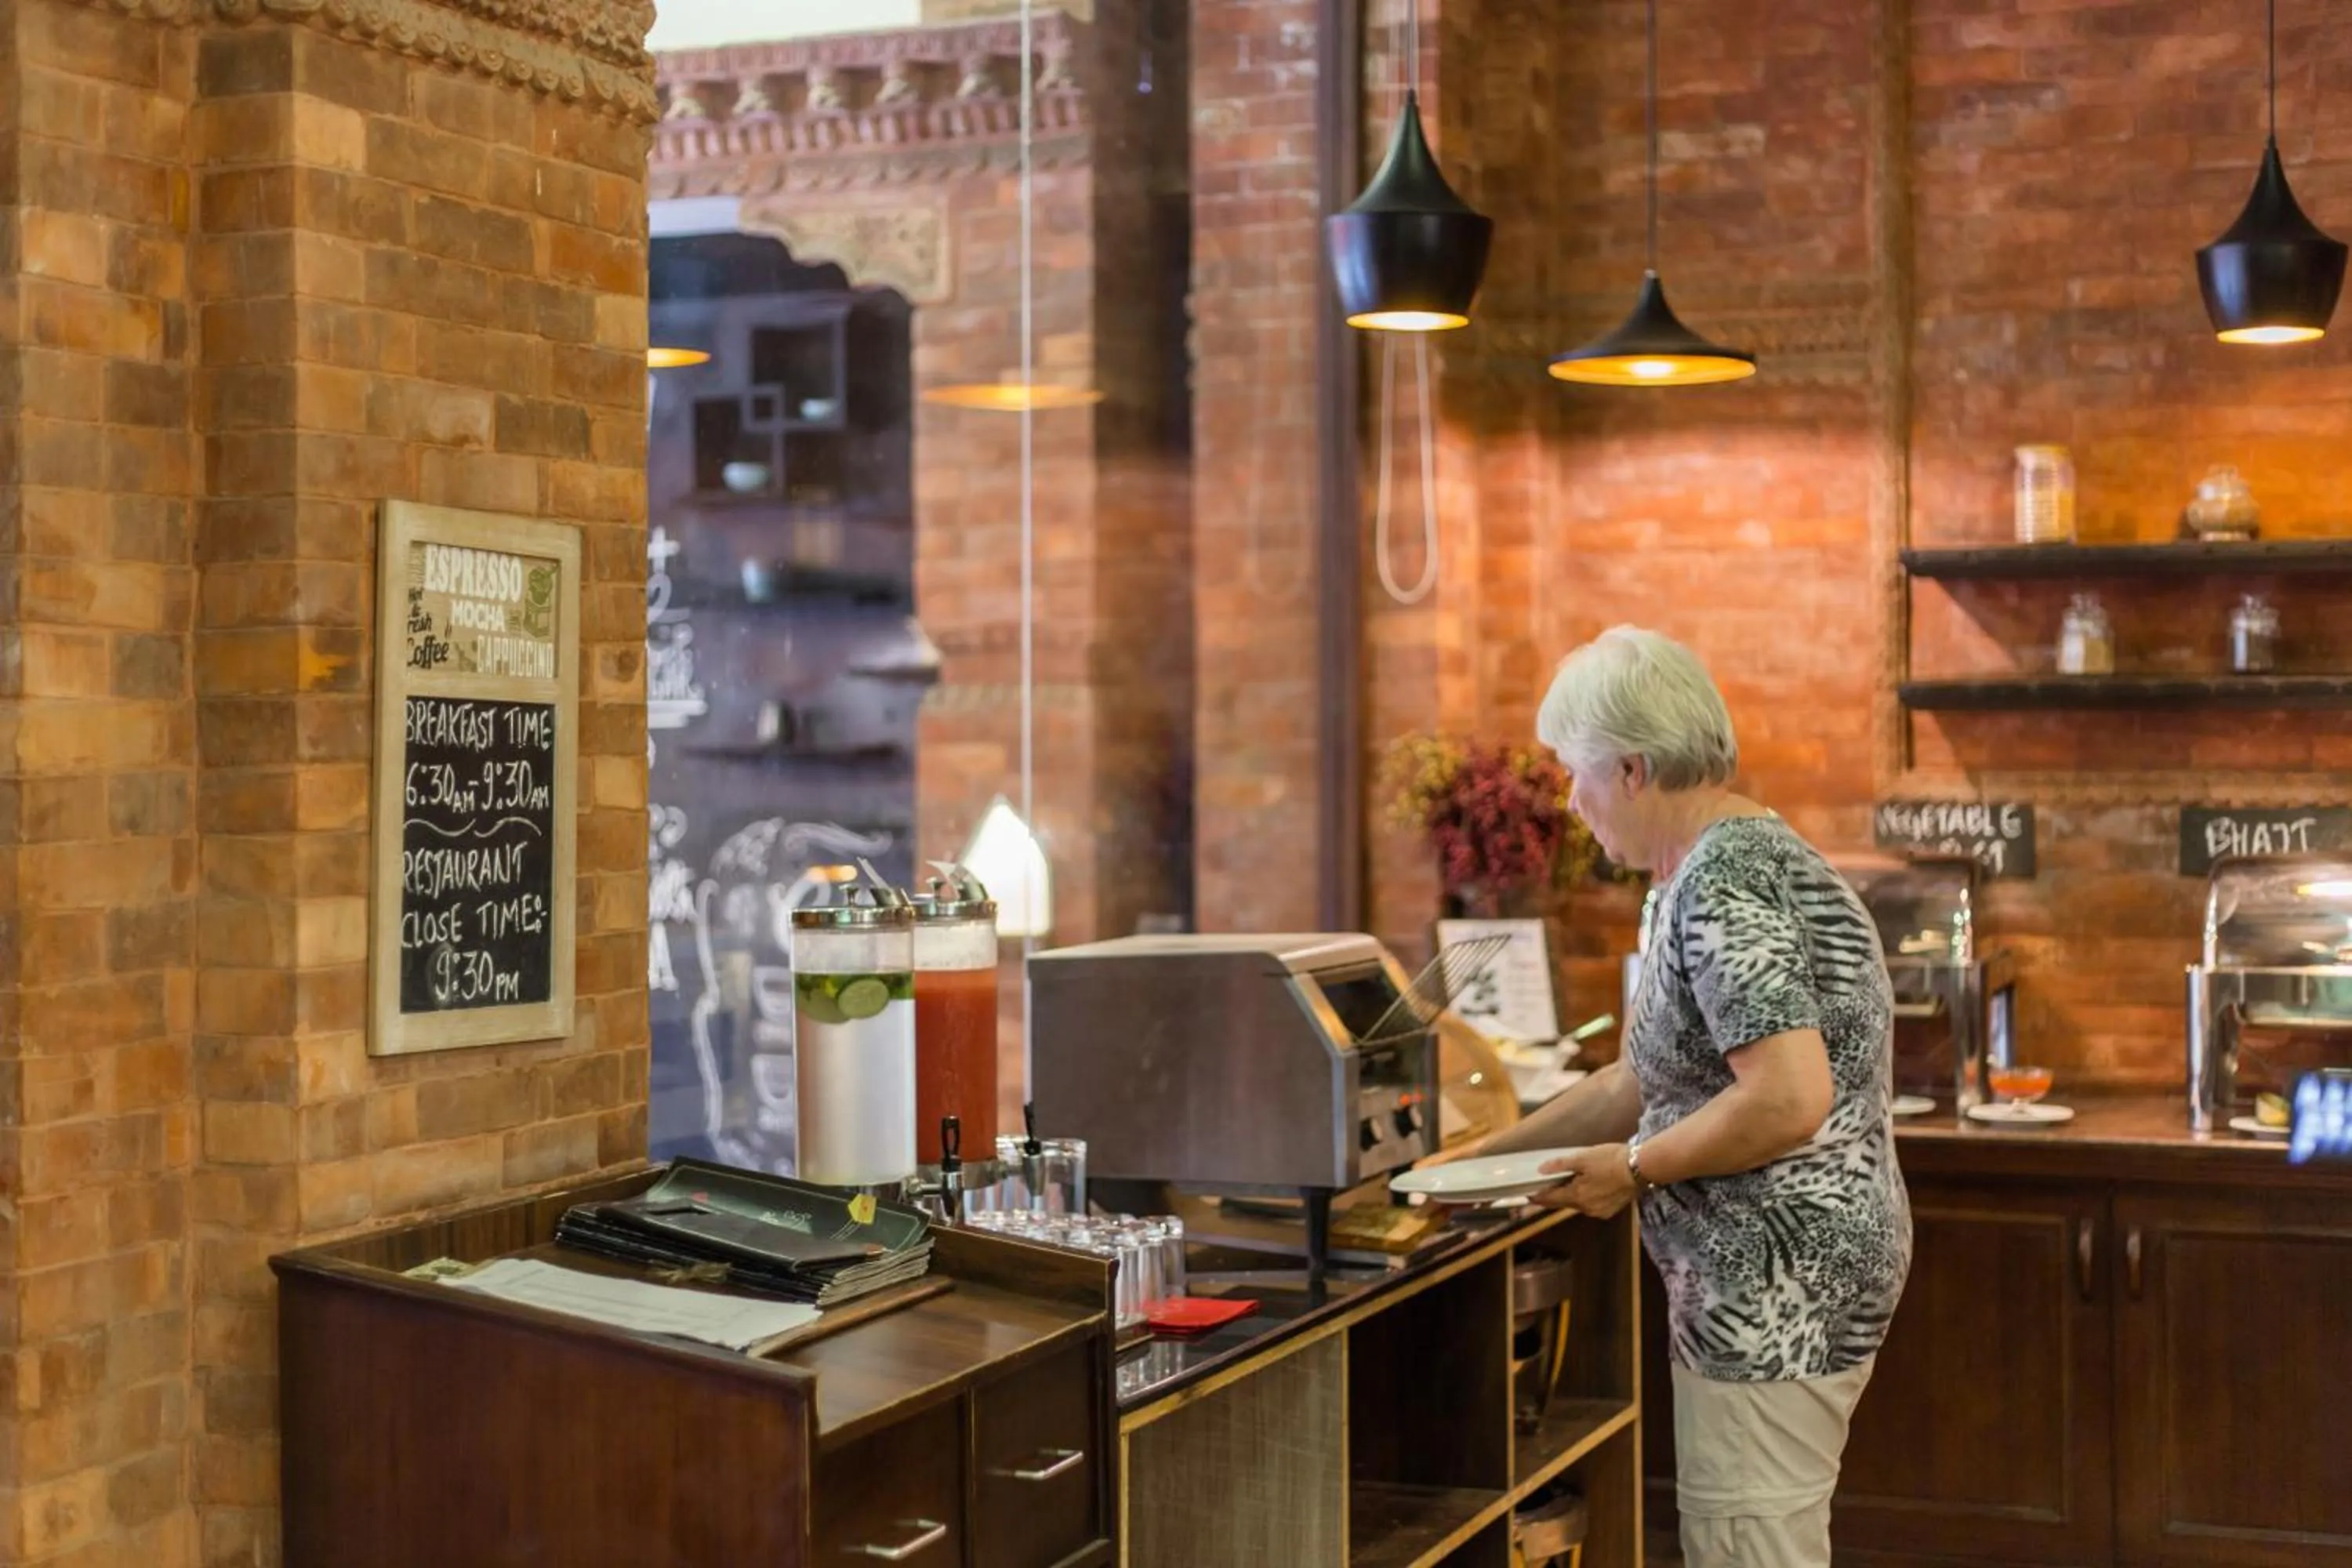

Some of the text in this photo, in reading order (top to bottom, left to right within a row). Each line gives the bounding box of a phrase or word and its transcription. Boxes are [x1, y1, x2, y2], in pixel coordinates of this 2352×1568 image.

[424, 545, 523, 603] ESPRESSO
[451, 599, 506, 632] MOCHA
[477, 635, 554, 677] CAPPUCCINO
[405, 700, 552, 751] BREAKFAST TIME
[404, 841, 528, 900] RESTAURANT
[401, 902, 463, 949] CLOSE
